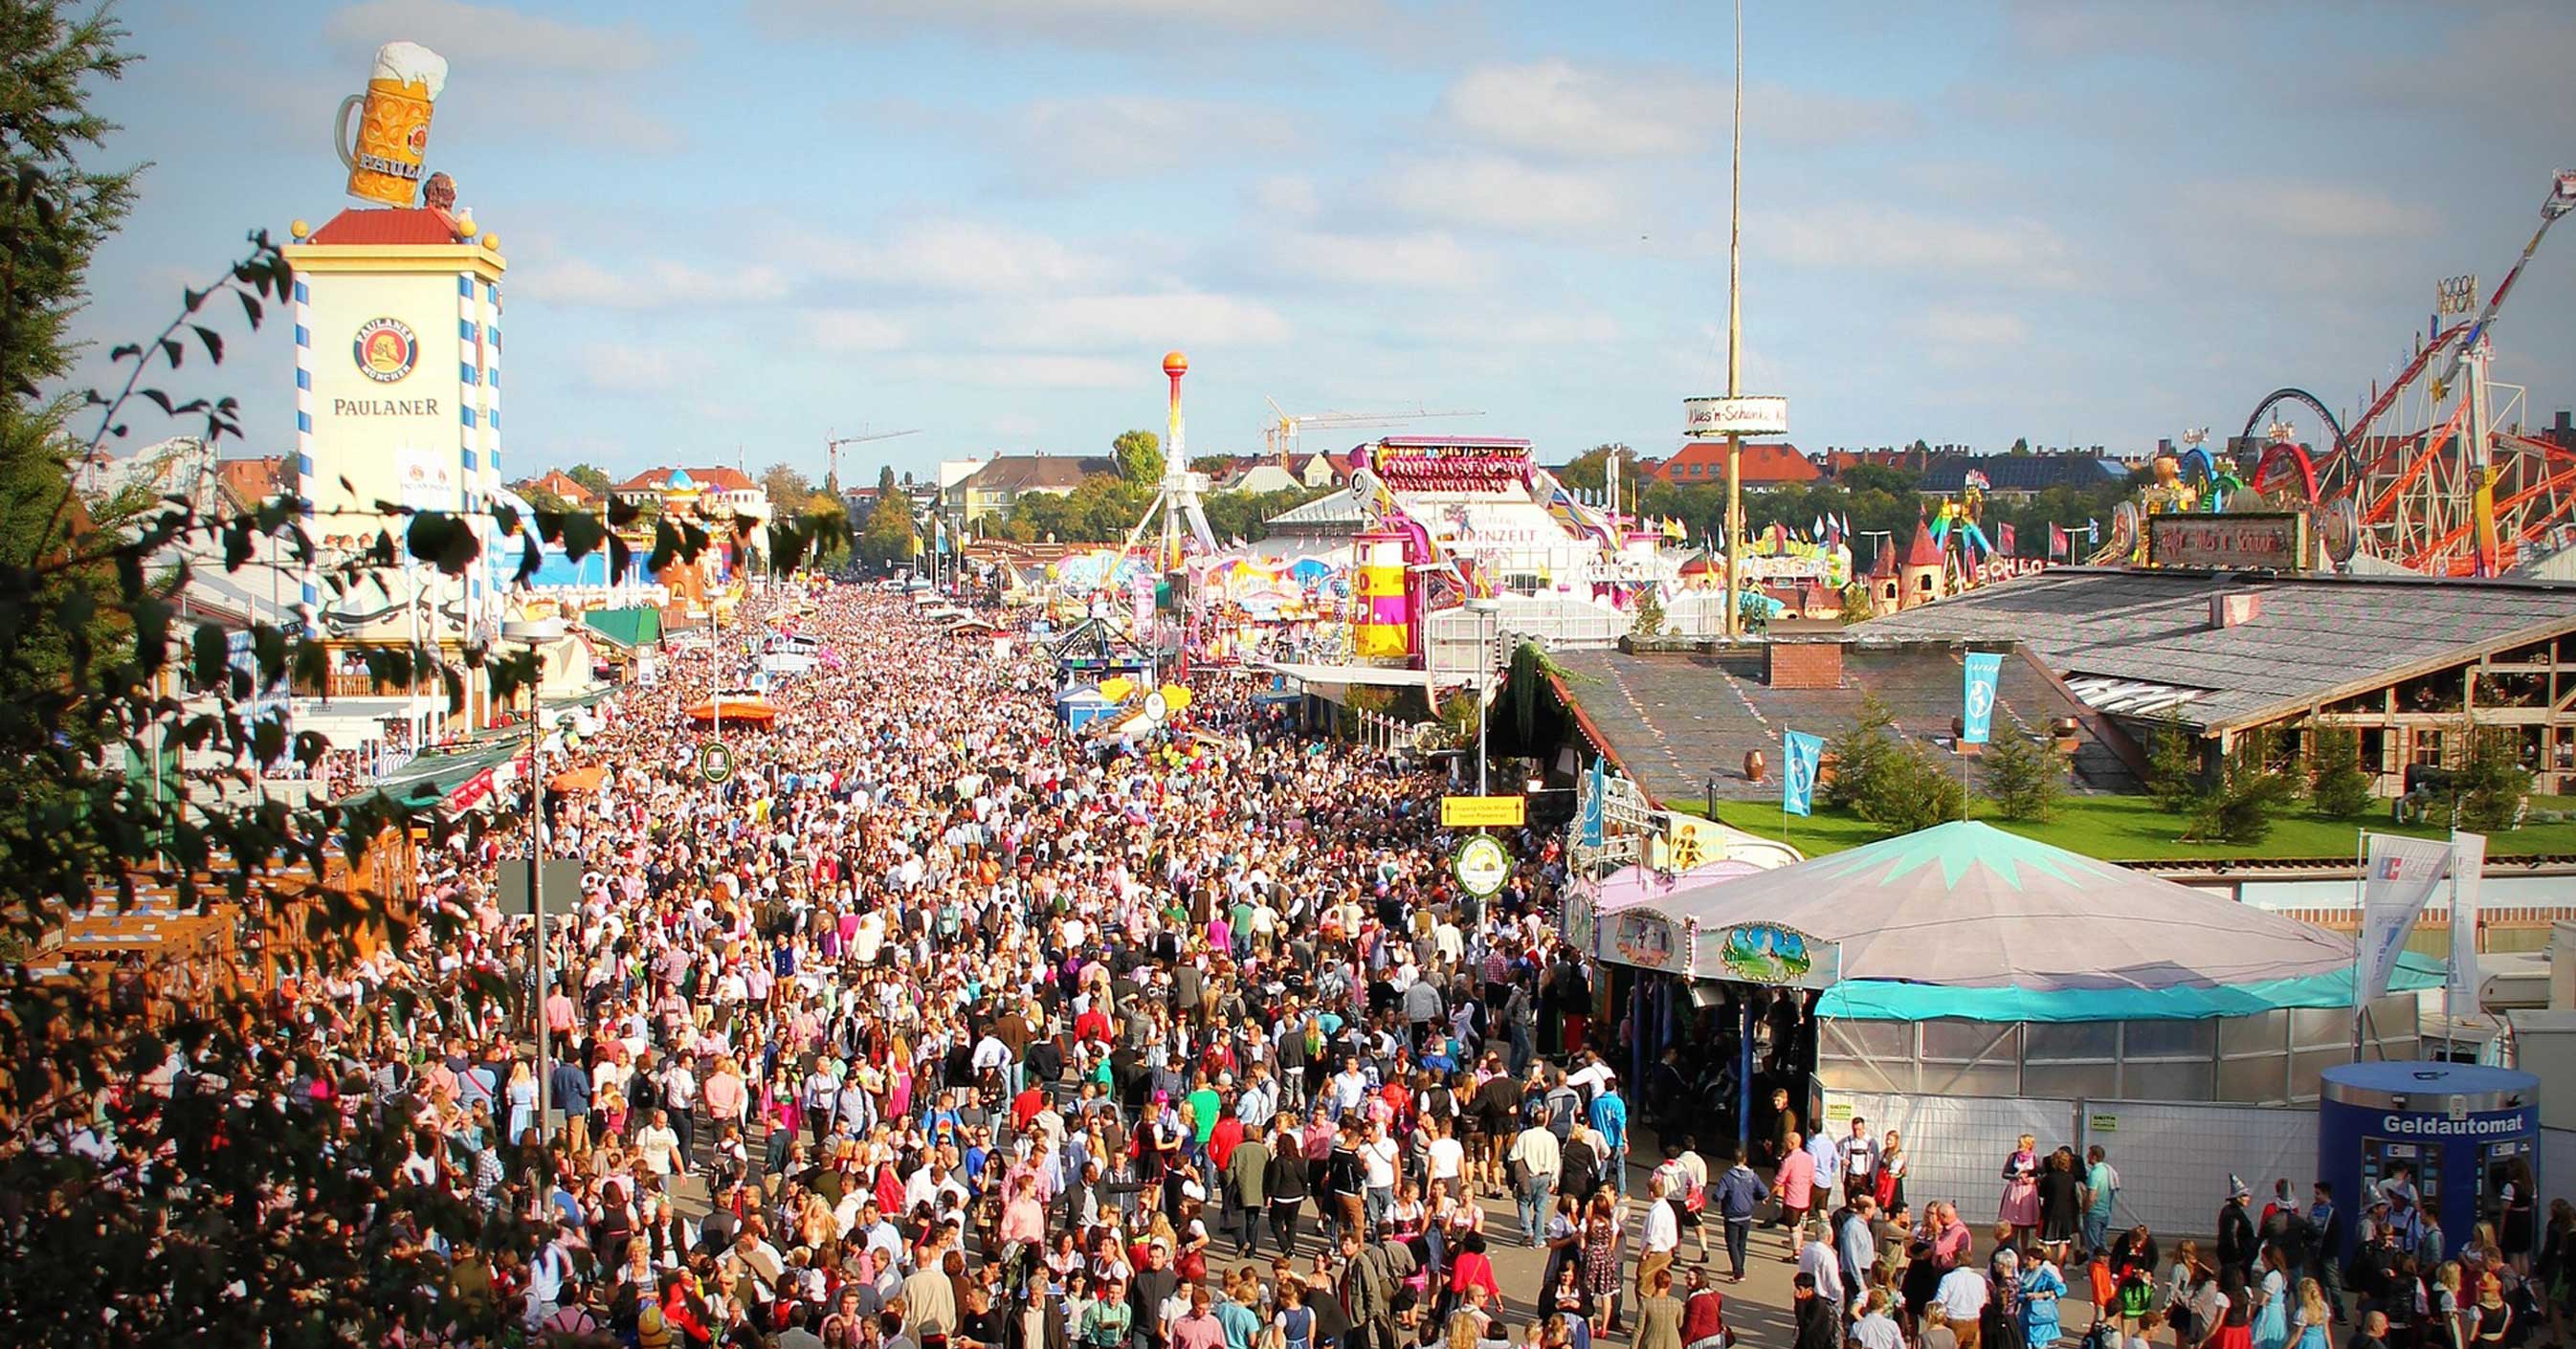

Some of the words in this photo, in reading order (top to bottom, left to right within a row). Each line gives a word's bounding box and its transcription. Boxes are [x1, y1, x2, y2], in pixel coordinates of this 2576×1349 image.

[355, 317, 415, 343] PAULANER
[361, 365, 411, 383] MÜNCHEN
[334, 398, 440, 416] PAULANER
[1975, 558, 2059, 580] SCHLO
[2383, 1114, 2524, 1135] Geldautomat
